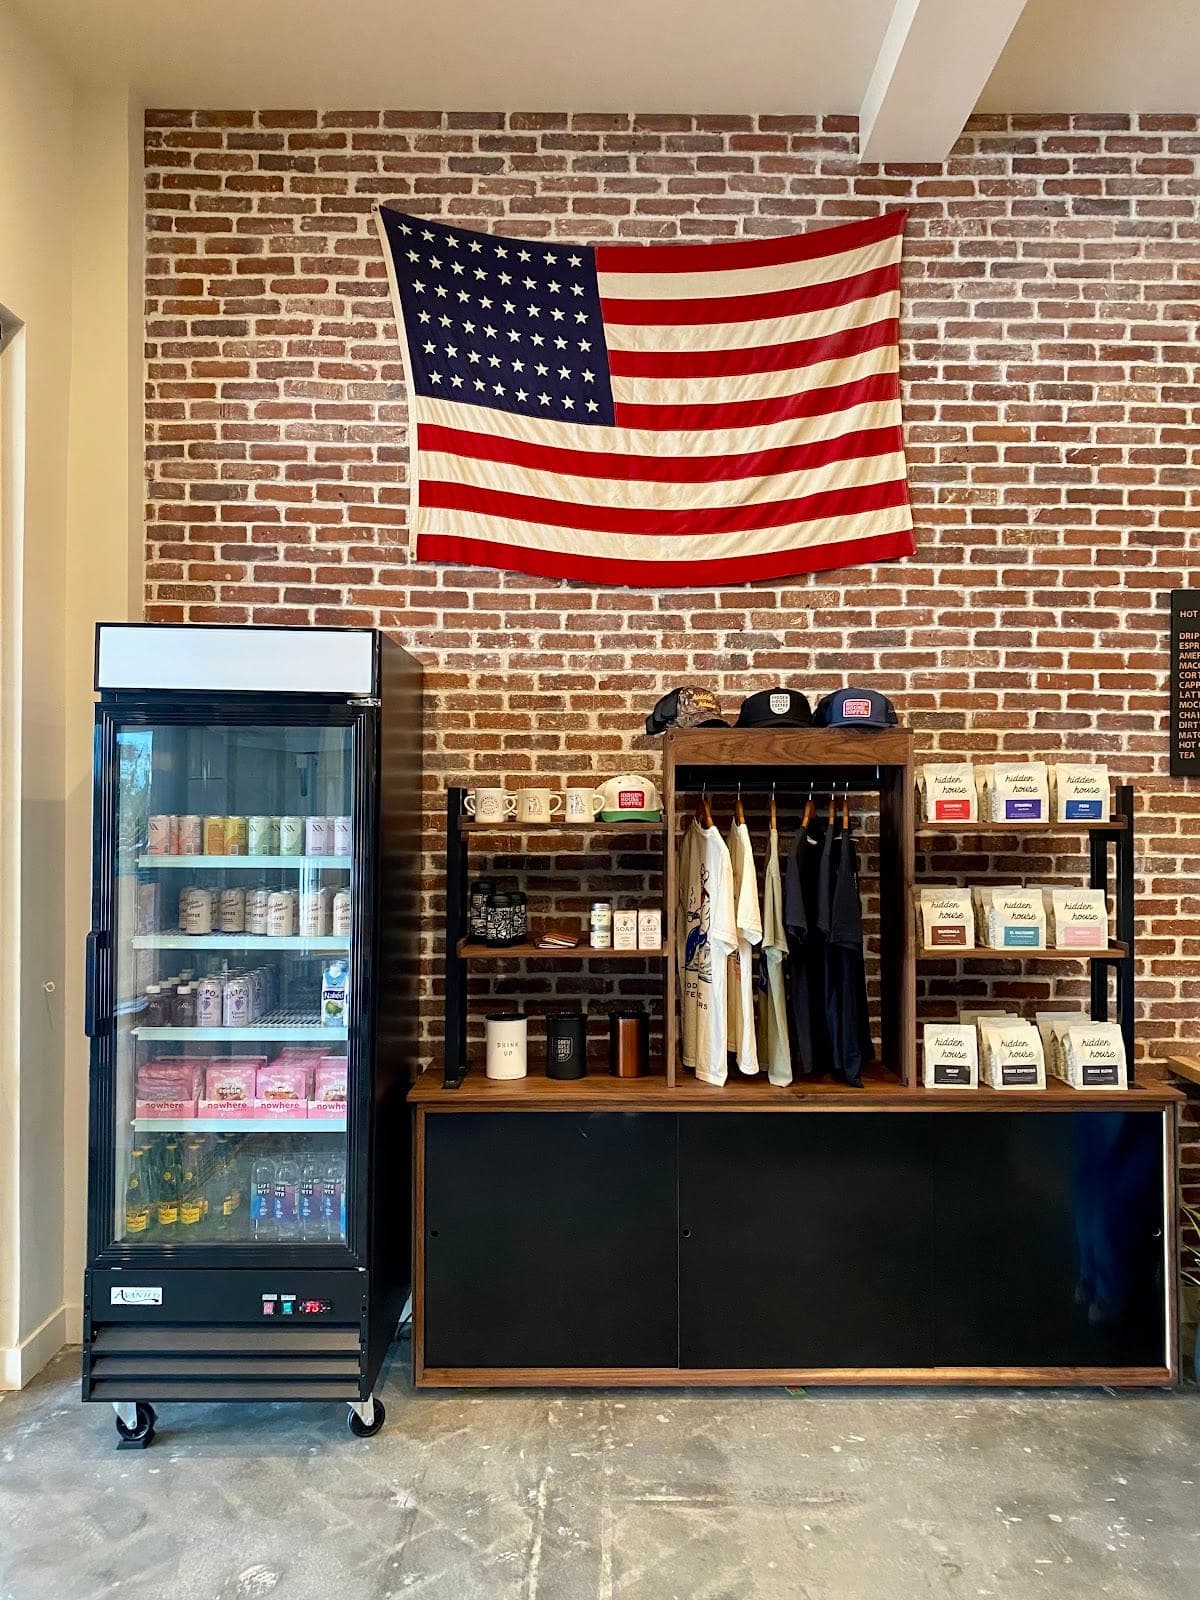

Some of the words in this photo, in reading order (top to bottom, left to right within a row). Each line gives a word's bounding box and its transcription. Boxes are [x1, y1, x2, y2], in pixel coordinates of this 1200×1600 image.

[1180, 610, 1199, 618] HOT
[1179, 701, 1200, 709] MOC
[1178, 741, 1196, 749] HOT
[1179, 751, 1196, 759] TEA
[934, 775, 963, 784] hidden
[1005, 774, 1034, 783] hidden
[1066, 775, 1096, 784] hidden
[942, 785, 967, 794] house
[1012, 784, 1039, 793] house
[1073, 785, 1100, 794] house
[931, 901, 960, 909] hidden
[1003, 901, 1032, 910] hidden
[1064, 902, 1094, 910] hidden
[938, 911, 964, 920] house
[1011, 912, 1037, 920] house
[1071, 912, 1099, 921] house
[934, 1038, 964, 1047] hidden
[1000, 1039, 1029, 1048] hidden
[1081, 1039, 1111, 1047] hidden
[941, 1049, 968, 1059] house
[1008, 1049, 1035, 1058] house
[1089, 1050, 1116, 1059] house
